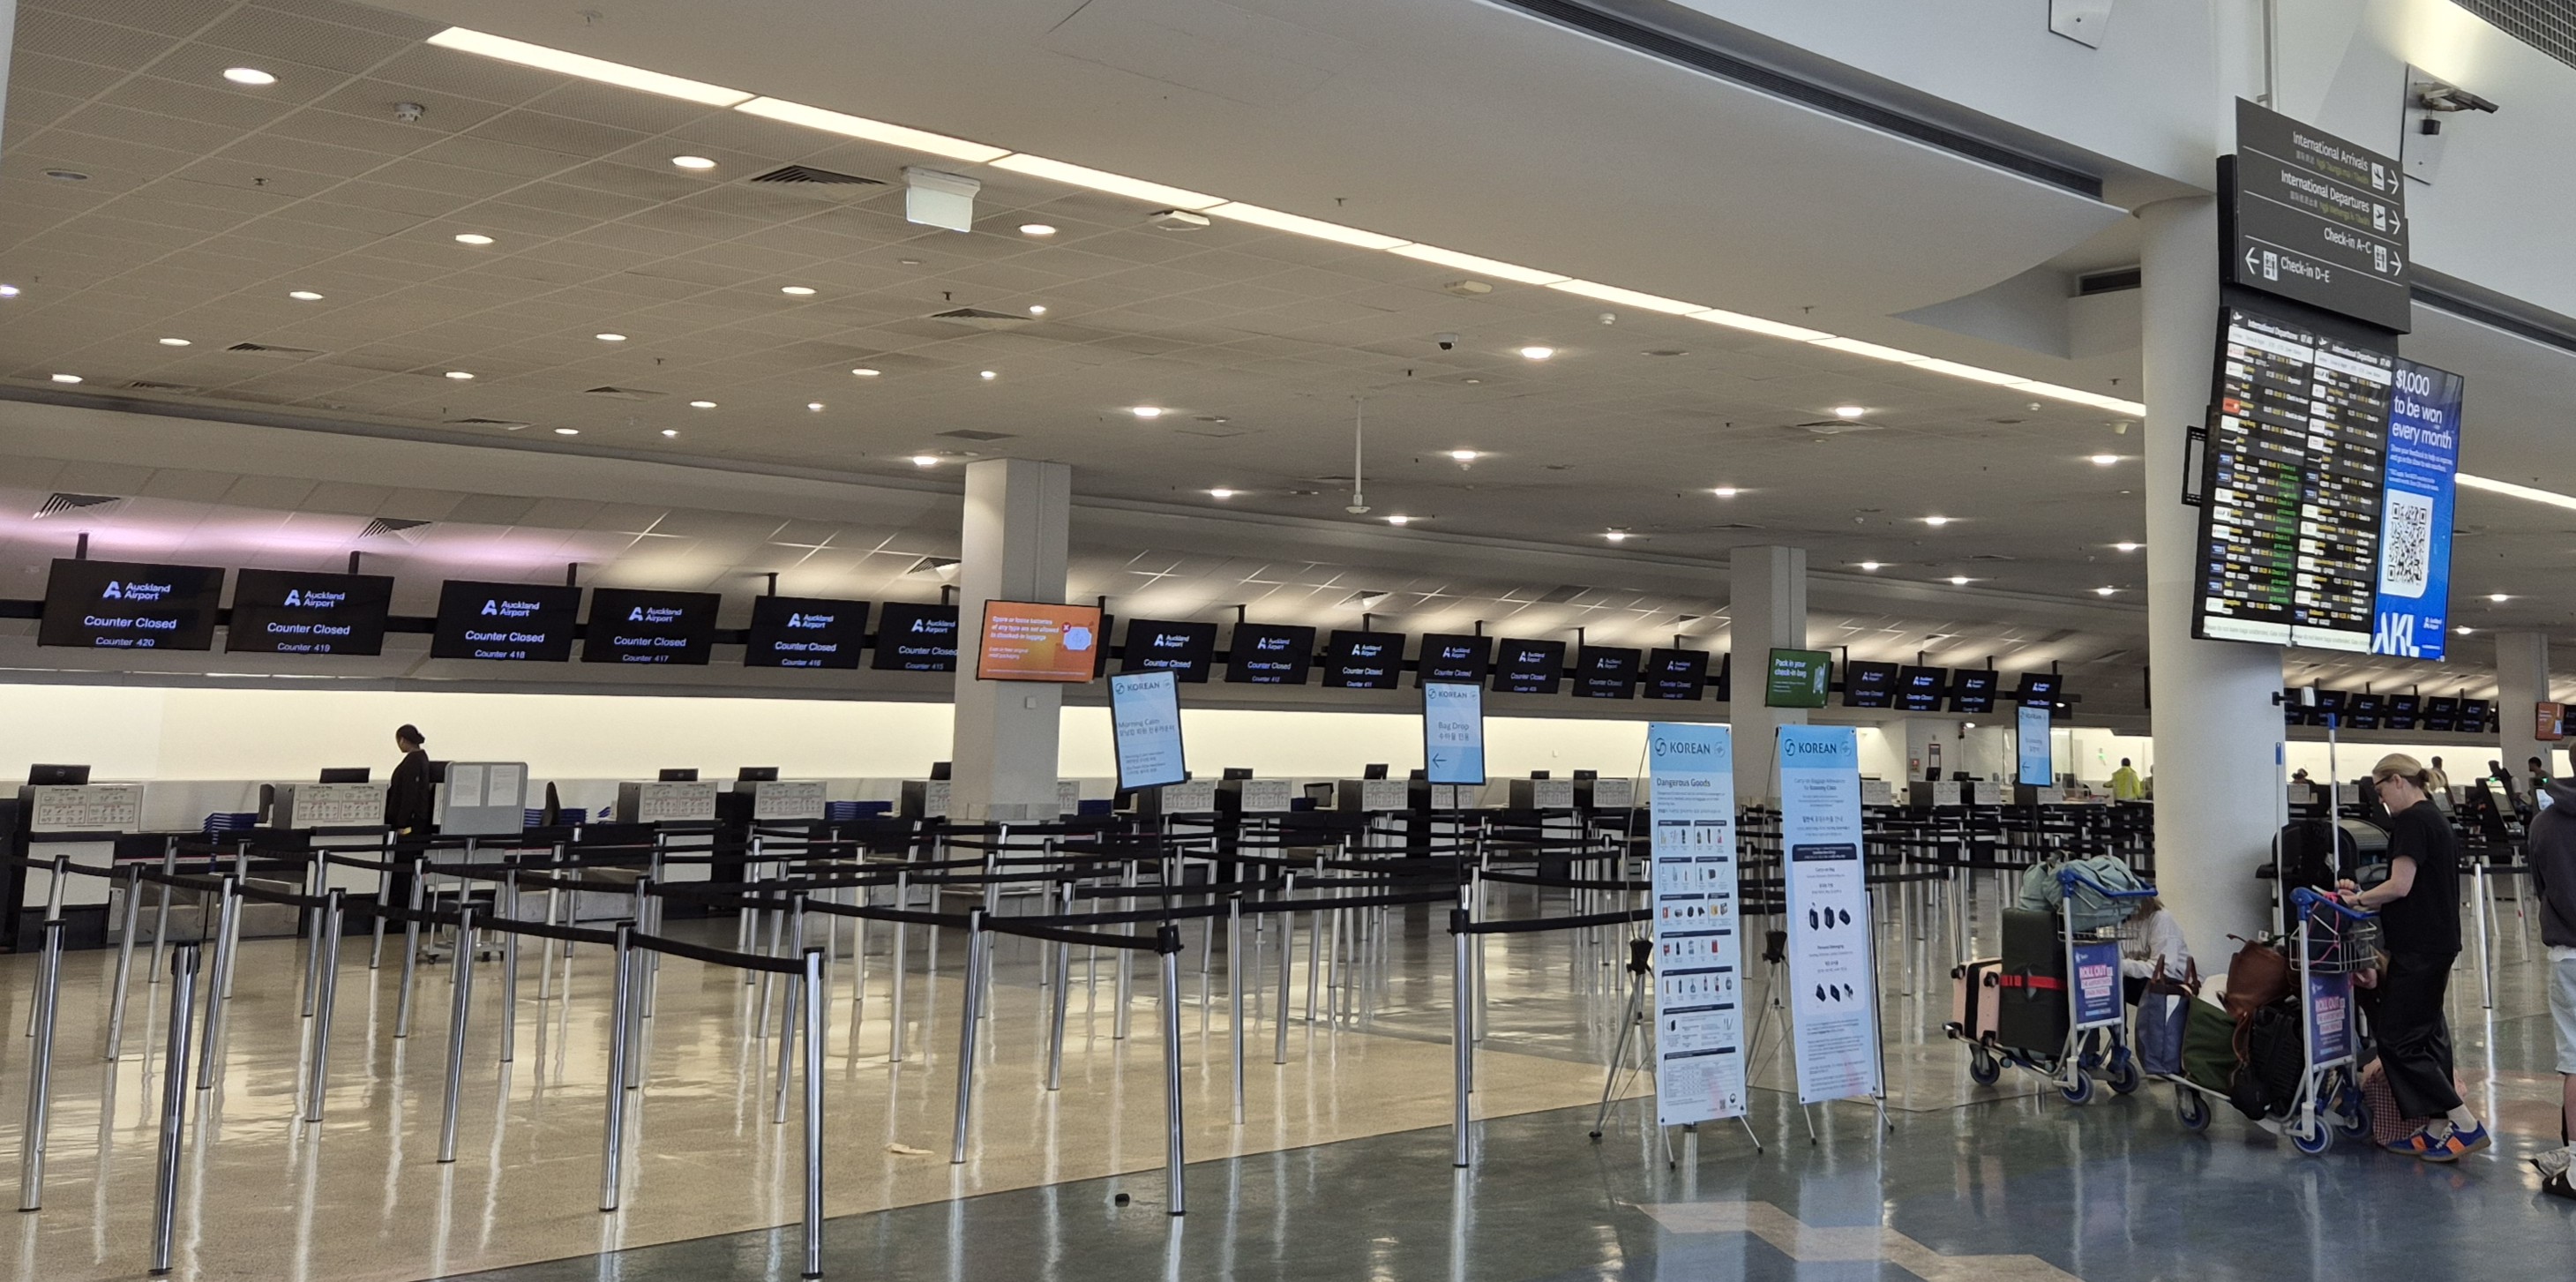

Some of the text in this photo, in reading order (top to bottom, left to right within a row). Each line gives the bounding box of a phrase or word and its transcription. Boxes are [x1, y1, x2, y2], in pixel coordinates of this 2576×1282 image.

[2293, 131, 2339, 161] International
[2340, 150, 2369, 171] Arrivals
[2280, 169, 2328, 198] International
[2330, 189, 2370, 214] Departures
[2324, 227, 2371, 254] Check-in A-C
[2280, 256, 2330, 282] Check-in D-E
[2395, 369, 2430, 397] $1,000
[2394, 395, 2443, 424] to be won
[2392, 421, 2452, 450] every month
[126, 582, 171, 593] Auckland
[124, 590, 159, 601] Airport
[304, 590, 346, 600] Auckland
[303, 598, 334, 608] Airport
[501, 600, 540, 611] Auckland
[499, 608, 530, 618] Airport
[647, 607, 682, 616] Auckland
[84, 616, 177, 629] Counter Closed
[645, 614, 672, 624] Airport
[803, 614, 834, 623] Auckland
[267, 622, 350, 635] Counter Closed
[802, 620, 826, 629] Airport
[465, 630, 544, 643] Counter Closed
[2371, 611, 2420, 658] AKL
[95, 636, 154, 647] Counter 420
[278, 642, 311, 651] Counter
[614, 636, 686, 647] Counter Closed
[775, 641, 836, 652] Counter Closed
[475, 649, 506, 658] Counter
[898, 646, 930, 655] Counter
[1775, 658, 1788, 667] Pack
[1127, 682, 1160, 691] KOREAN
[1438, 722, 1469, 731] Bag Drop
[1670, 741, 1711, 754] KOREAN
[1799, 742, 1837, 754] KOREAN
[1657, 777, 1711, 788] Dangerous Goods
